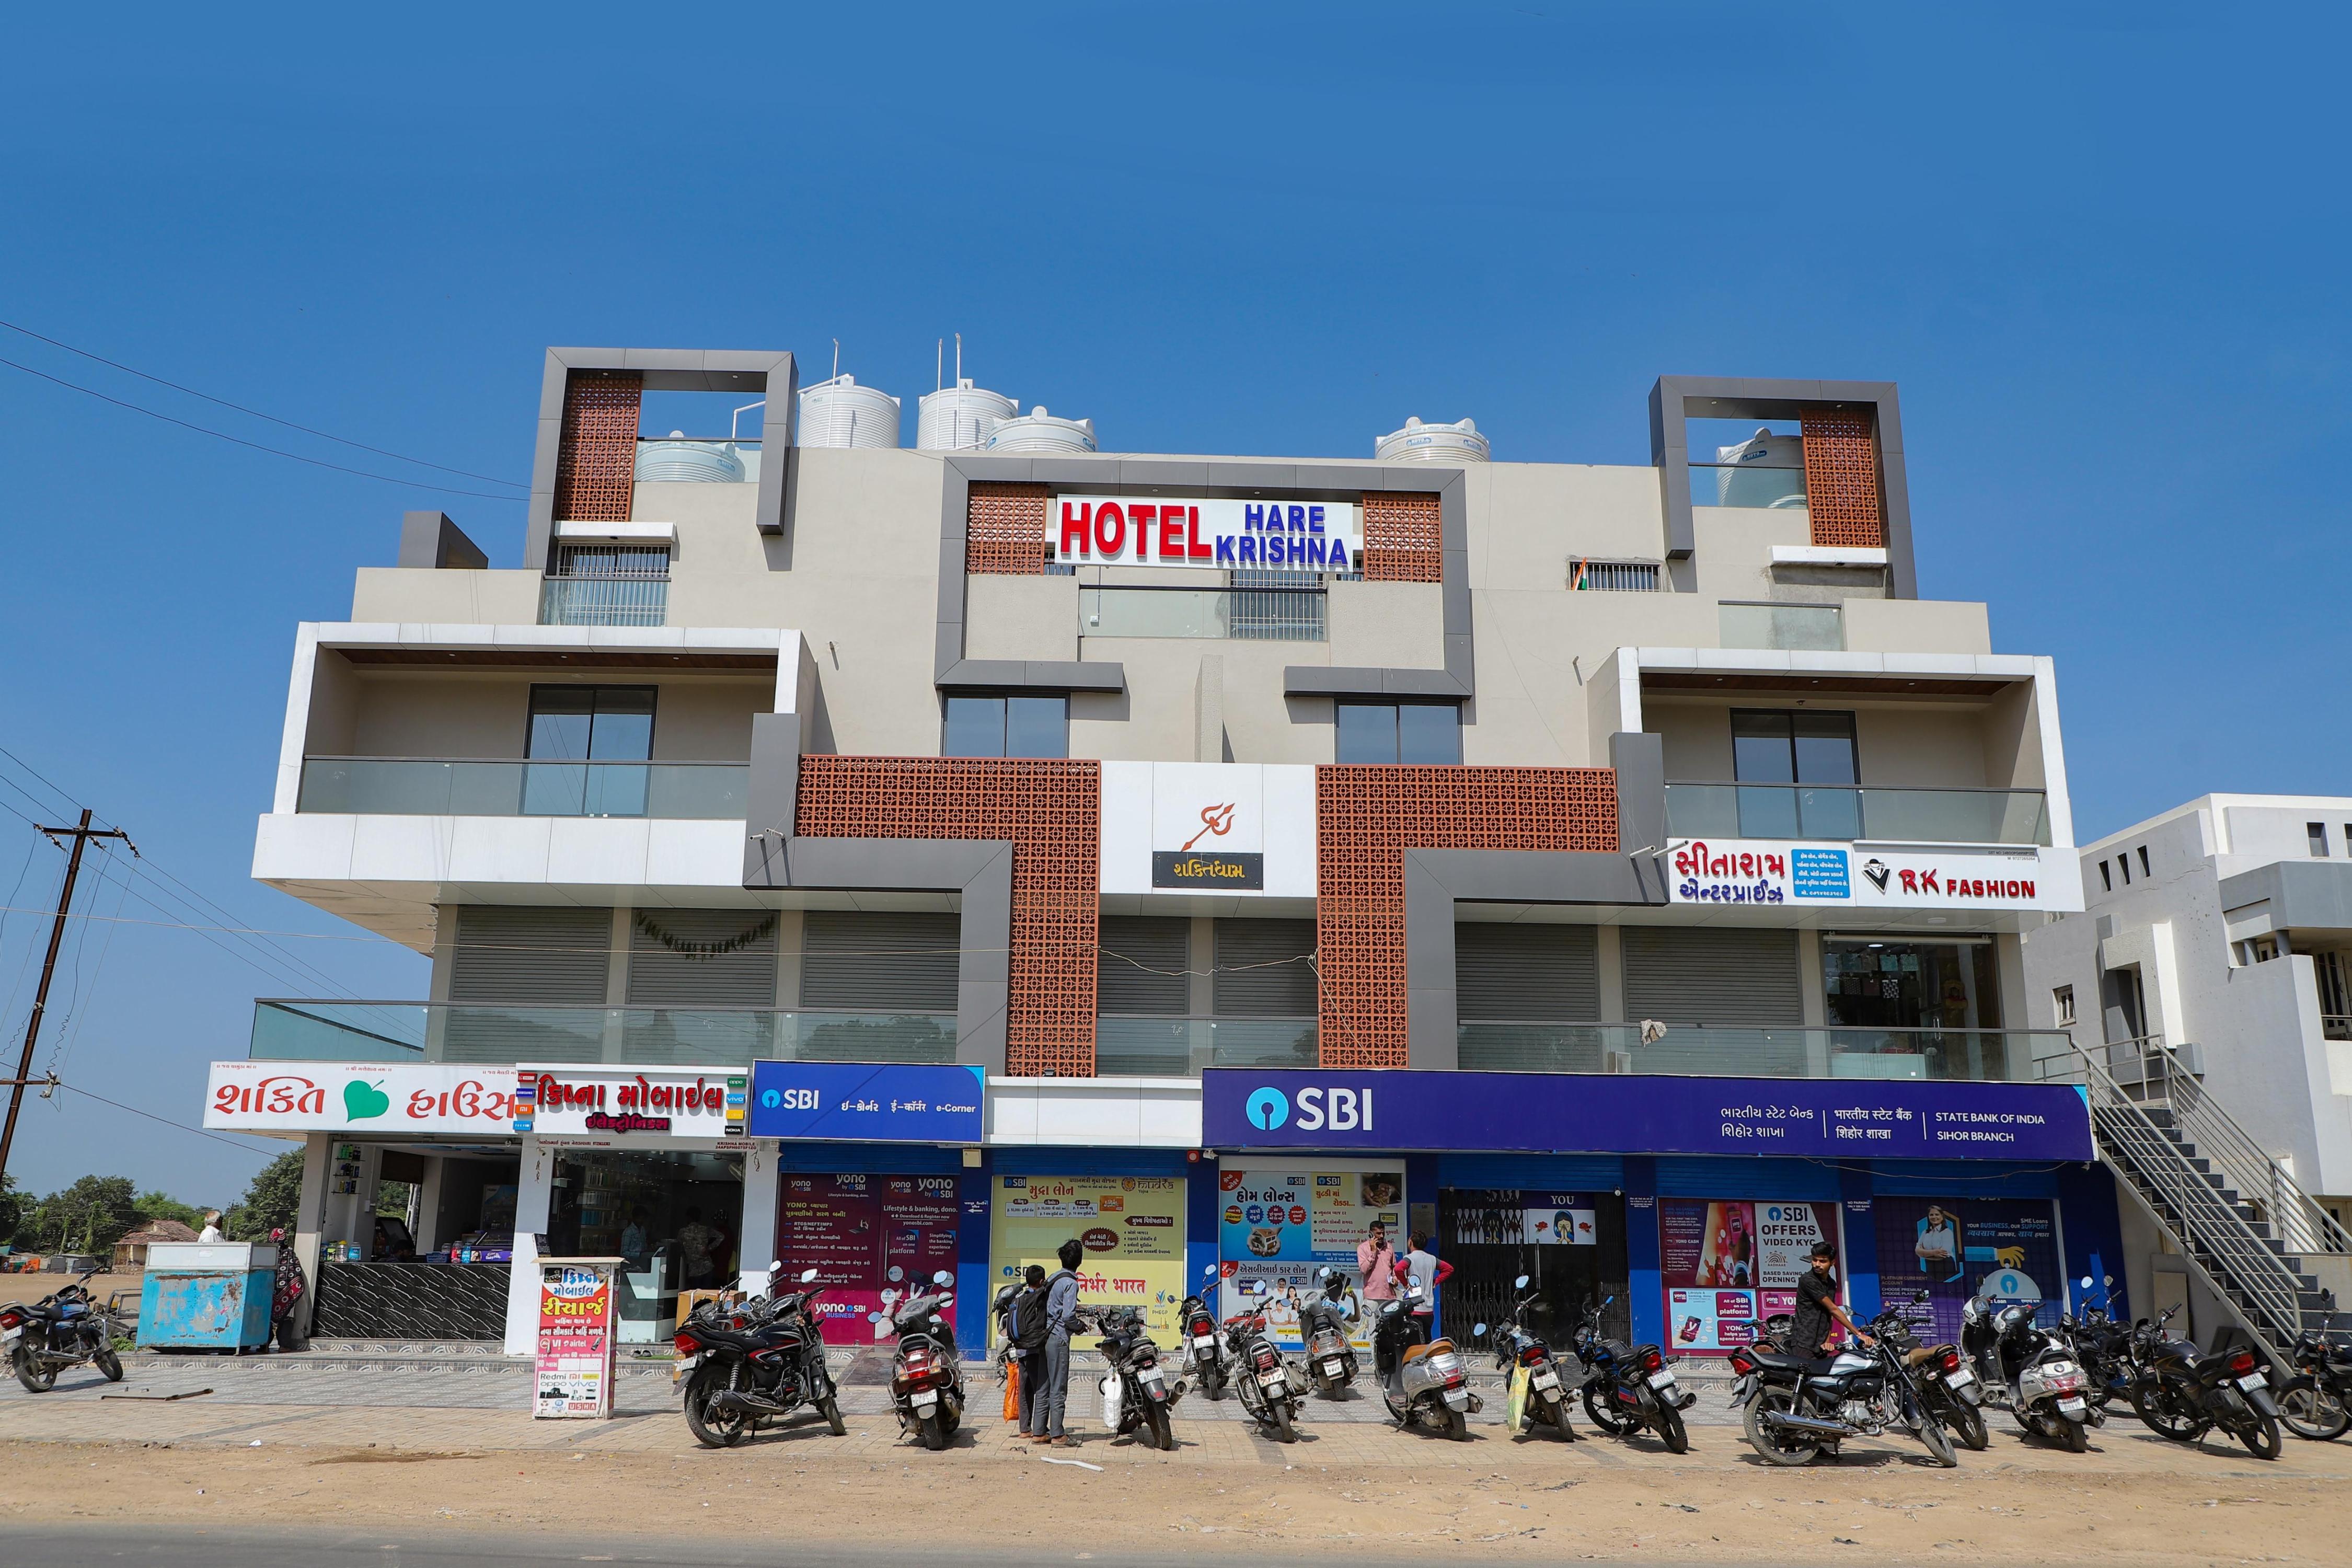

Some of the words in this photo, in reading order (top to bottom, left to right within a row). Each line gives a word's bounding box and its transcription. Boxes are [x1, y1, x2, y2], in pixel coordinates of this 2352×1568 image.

[1245, 503, 1324, 533] HARE
[1060, 502, 1213, 559] HOTEL
[1216, 535, 1348, 566] KRISHNA
[1675, 842, 1784, 877] સીતારામ
[1173, 859, 1246, 878] શક્તિધામ
[1947, 879, 2035, 897] FASHION
[213, 1076, 325, 1114] શક્તિ
[783, 1089, 820, 1110] SBI
[936, 1103, 976, 1114] e-Corner
[1296, 1087, 1373, 1131] SBI
[1721, 1105, 1761, 1118] ભારતીય
[1766, 1105, 1786, 1119] સ્ટેટ
[1790, 1105, 1814, 1120] બેન્ક
[1834, 1107, 1869, 1120] भारतीय
[1872, 1107, 1893, 1120] स्टेट
[1895, 1107, 1912, 1121] बैंक
[1936, 1112, 1969, 1122] STATE
[1971, 1113, 1999, 1123] BANK
[2000, 1114, 2014, 1123] OF
[2016, 1115, 2045, 1124] INDIA
[1722, 1123, 1753, 1137] શિહોર
[1756, 1127, 1784, 1137] શાખા
[1836, 1125, 1863, 1139] शिहोर
[1866, 1129, 1892, 1139] शाखा
[1937, 1131, 1969, 1140] SIHOR
[1971, 1132, 2014, 1142] BRANCH
[836, 1174, 866, 1185] yono
[891, 1181, 911, 1190] yono
[918, 1178, 953, 1192] yono
[1013, 1179, 1025, 1187] SBI
[1550, 1195, 1574, 1205] YOU
[1784, 1207, 1808, 1221] SBI
[1761, 1225, 1816, 1236] OFFERS
[1076, 1272, 1108, 1294] निर्भर
[1113, 1279, 1147, 1294] भारत
[1782, 1297, 1796, 1305] YO
[815, 1303, 845, 1315] yono
